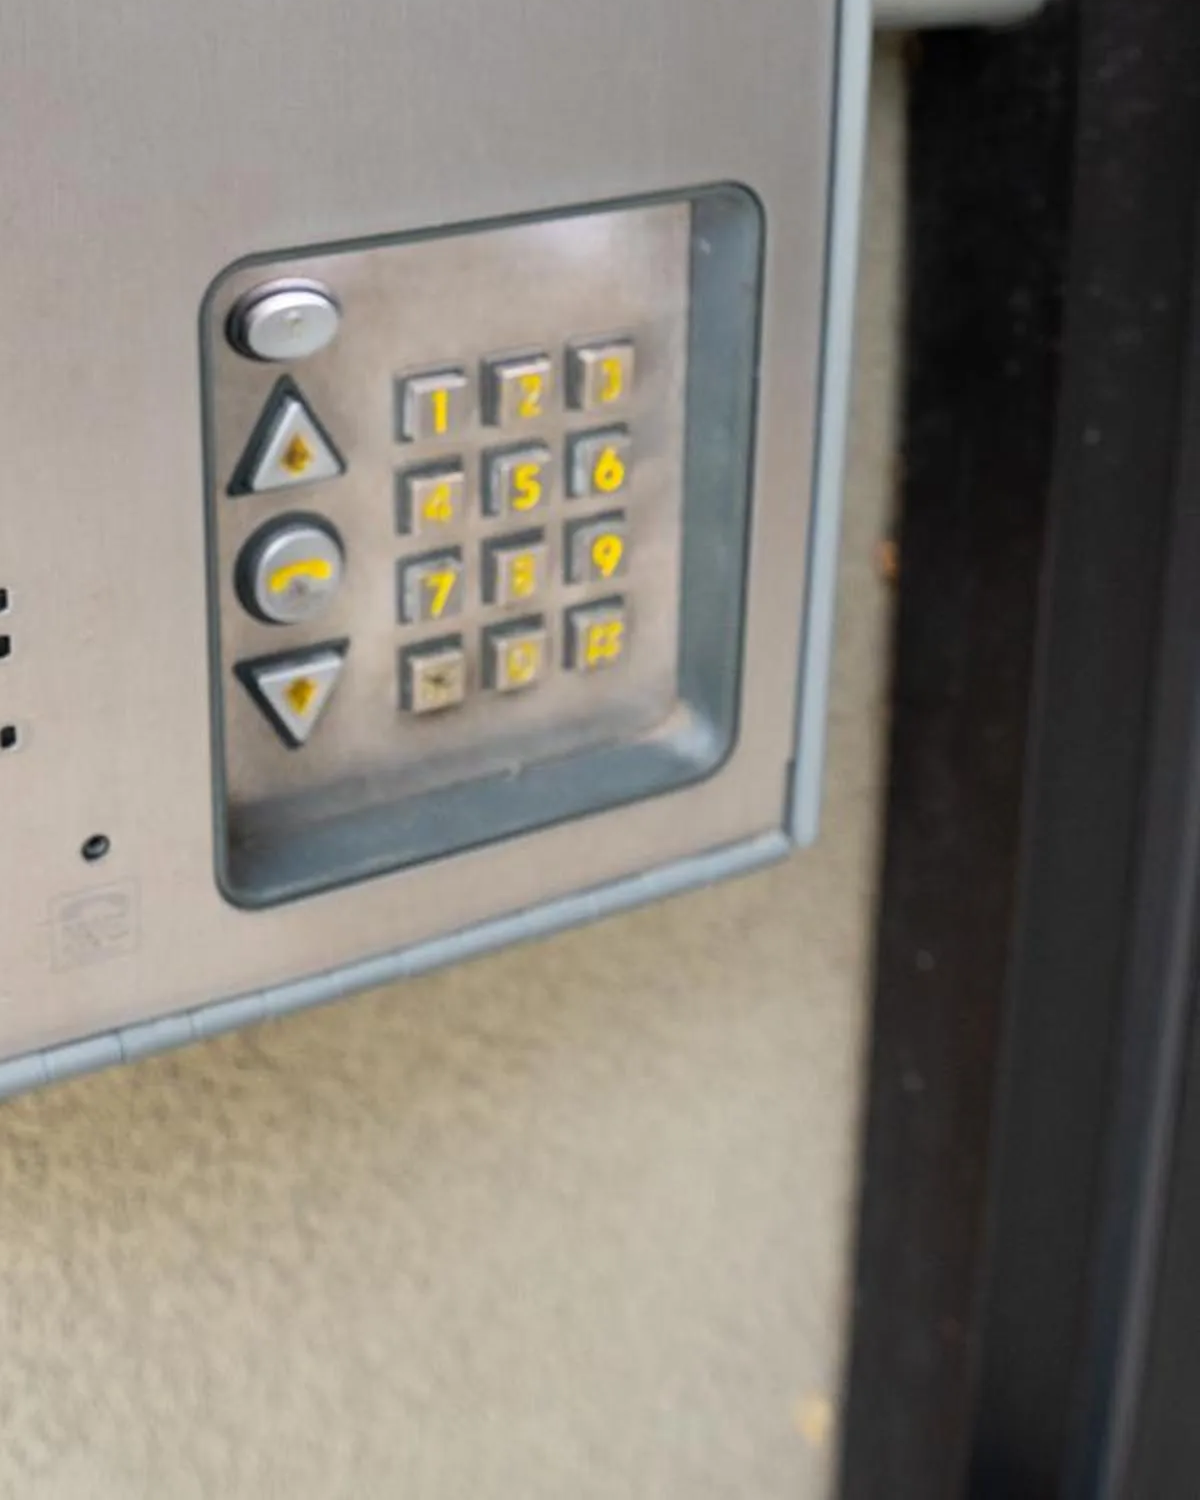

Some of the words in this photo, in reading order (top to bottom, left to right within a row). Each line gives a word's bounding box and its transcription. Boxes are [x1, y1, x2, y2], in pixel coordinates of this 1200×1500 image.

[431, 389, 449, 434] 1
[517, 373, 543, 418] 2
[422, 483, 453, 524] 4
[511, 462, 542, 511] 5
[592, 447, 625, 493] 6
[425, 570, 457, 615] 7
[591, 533, 624, 577] 9
